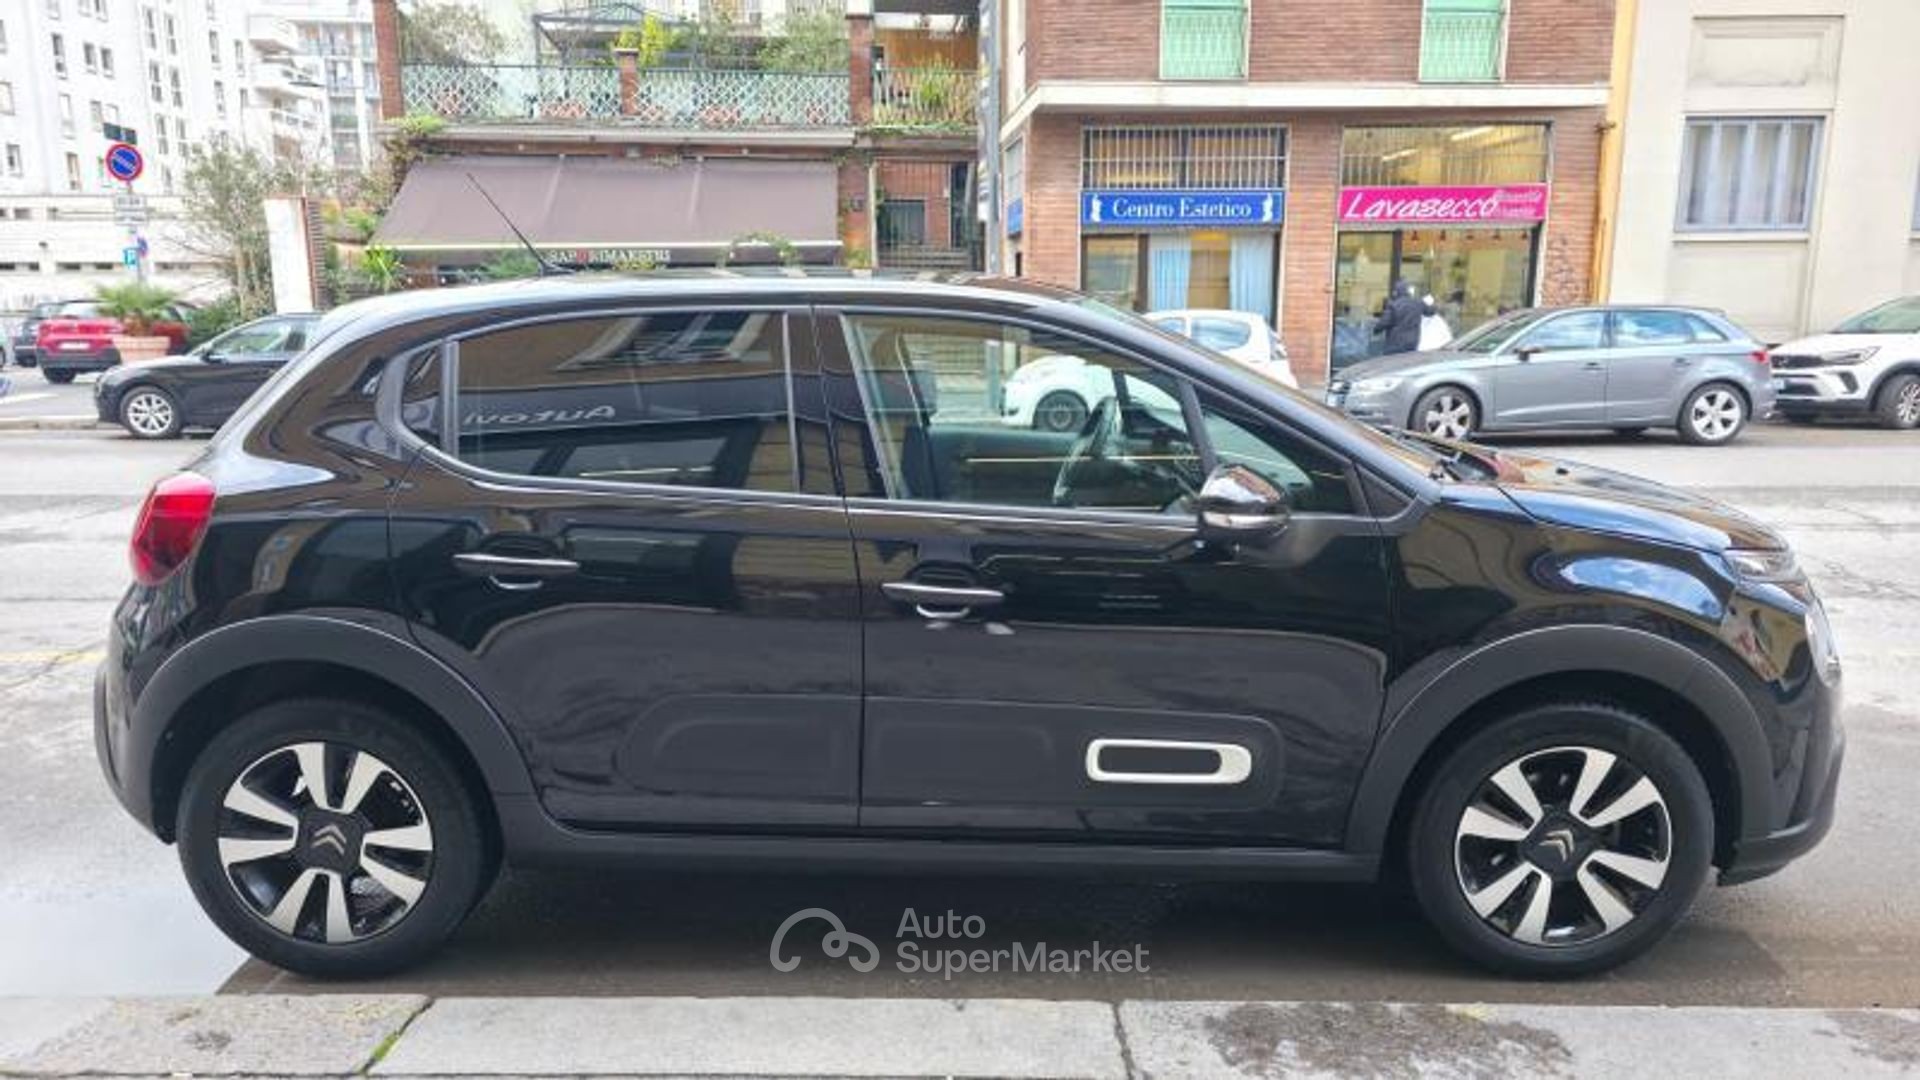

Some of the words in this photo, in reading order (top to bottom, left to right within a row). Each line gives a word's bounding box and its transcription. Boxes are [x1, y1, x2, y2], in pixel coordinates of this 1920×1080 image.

[1112, 197, 1174, 218] Centro
[1179, 196, 1252, 218] Estetico
[1343, 189, 1501, 218] Lavasecco
